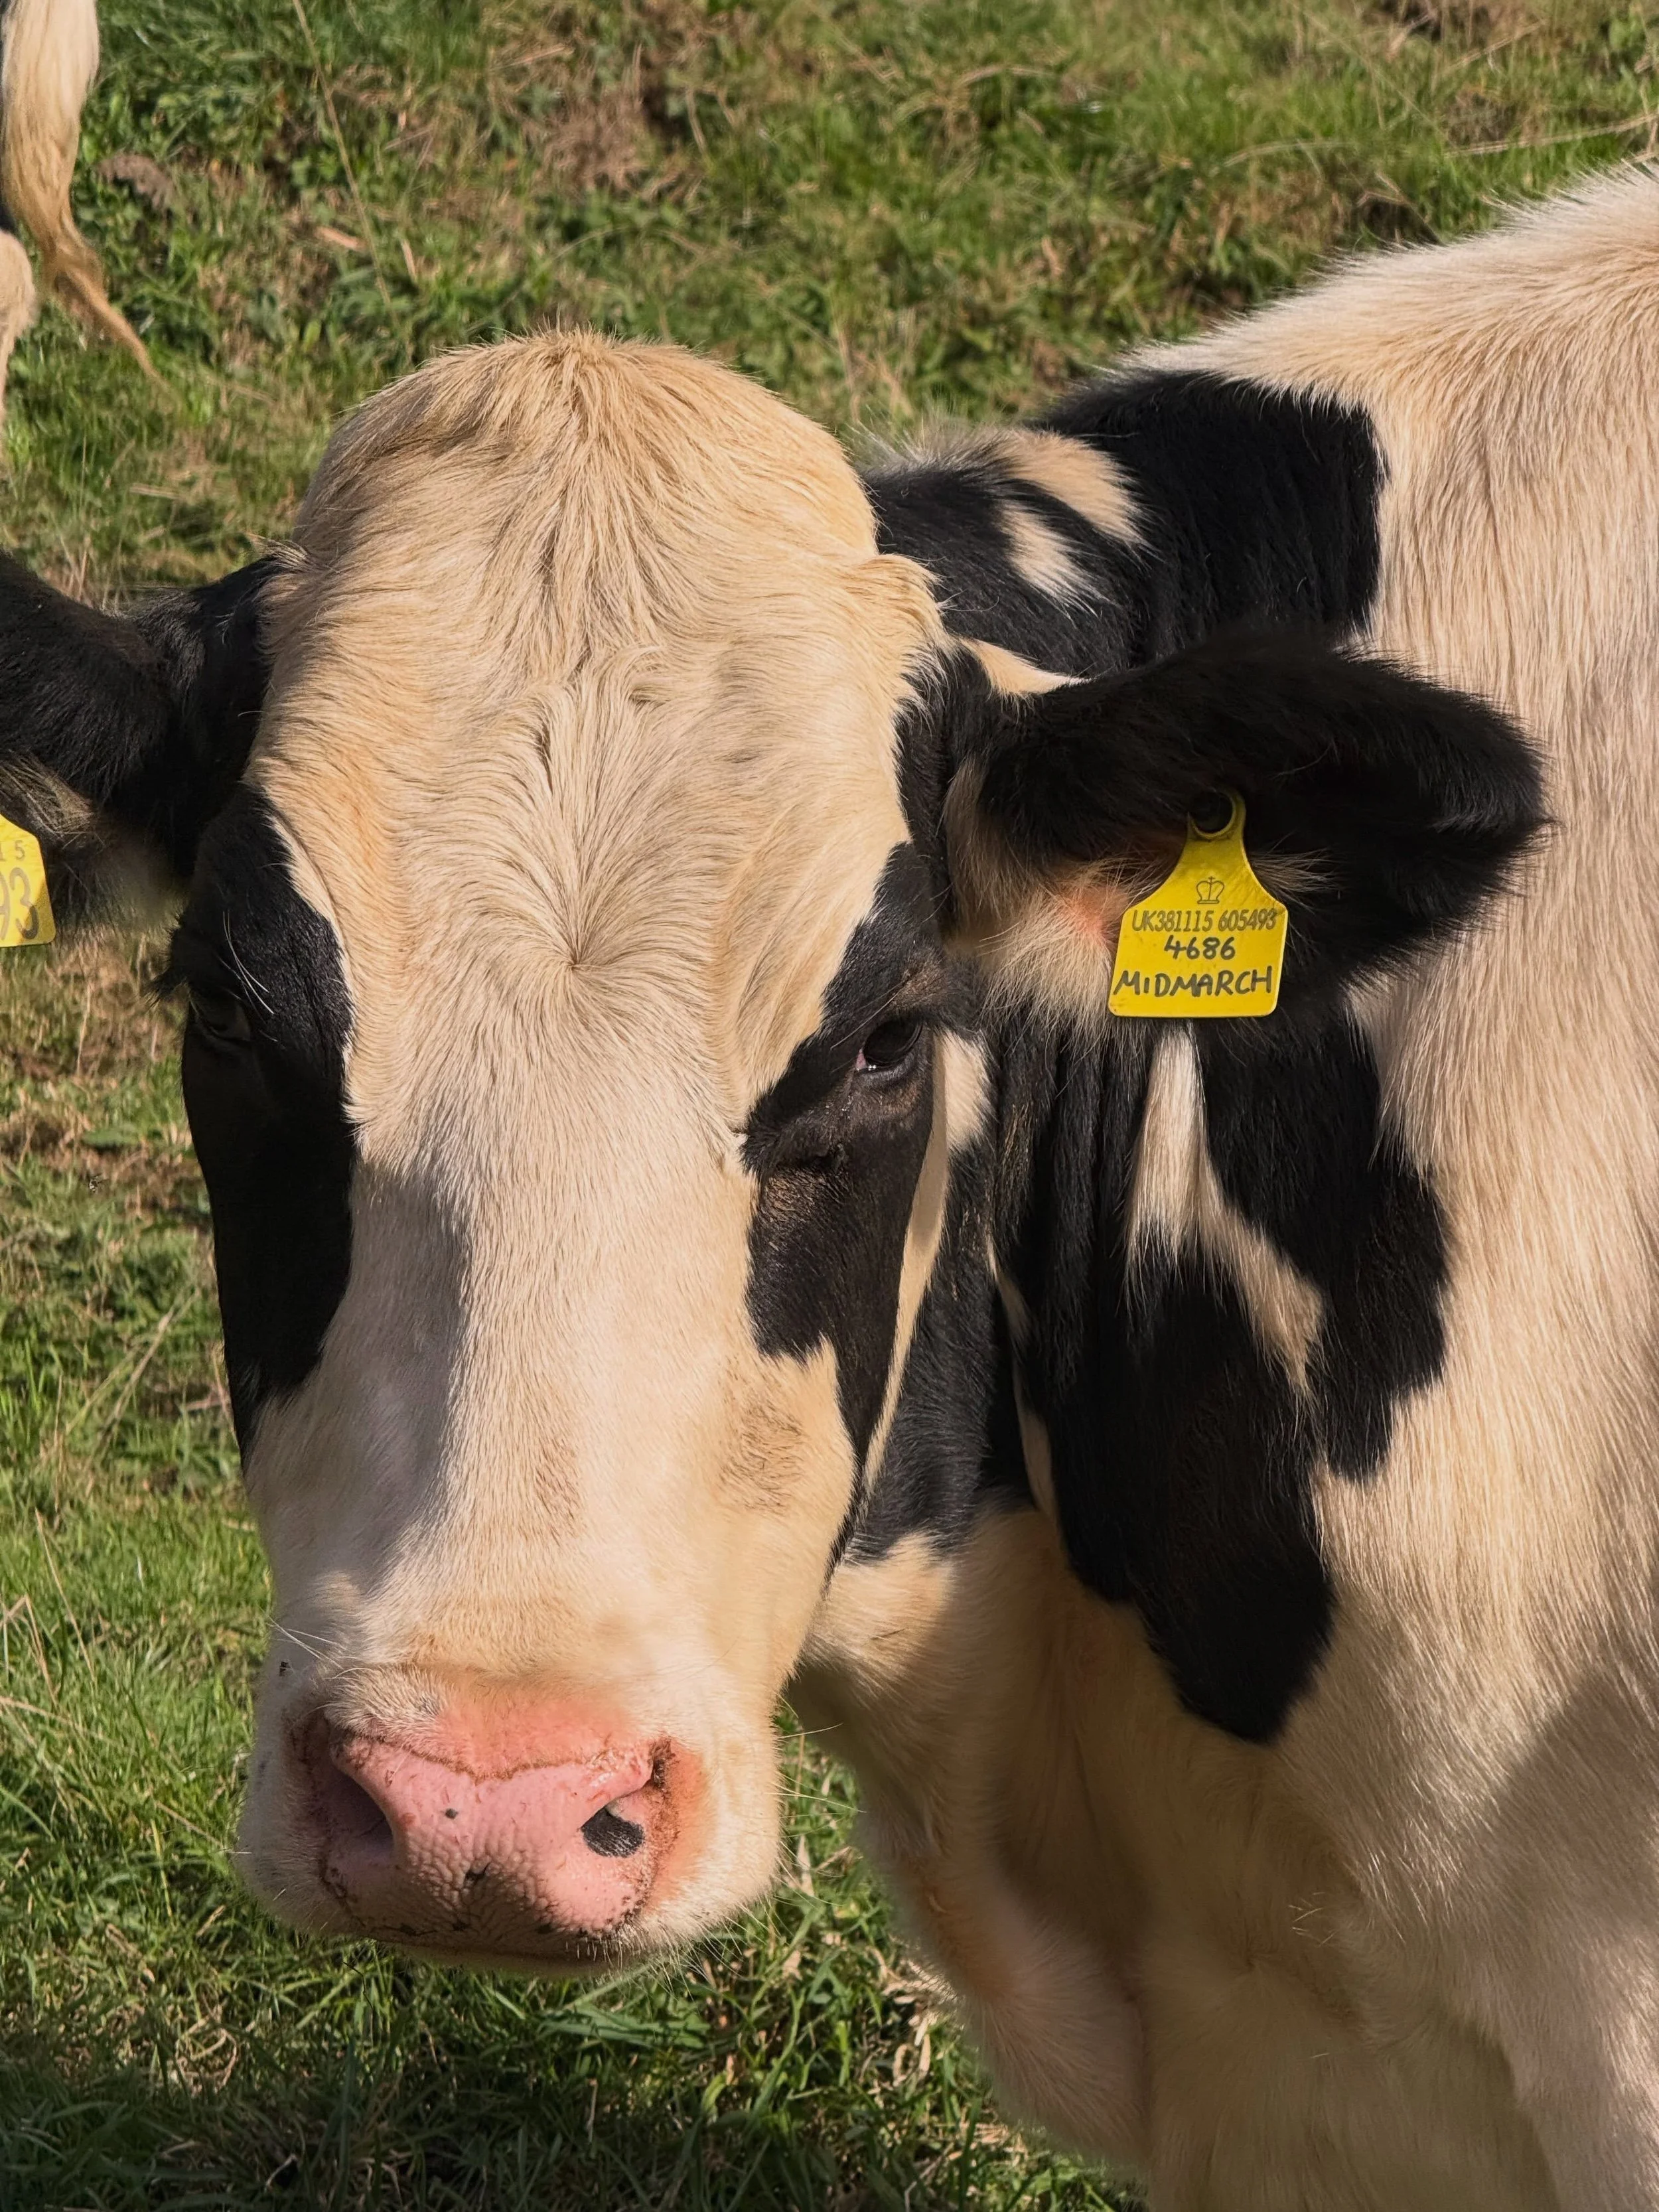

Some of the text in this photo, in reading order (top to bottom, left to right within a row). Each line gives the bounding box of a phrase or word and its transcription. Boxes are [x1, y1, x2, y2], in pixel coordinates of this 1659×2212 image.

[1132, 907, 1277, 932] UK381115 605493
[1164, 934, 1236, 960] 4686
[1114, 966, 1273, 997] MIDMARCH
